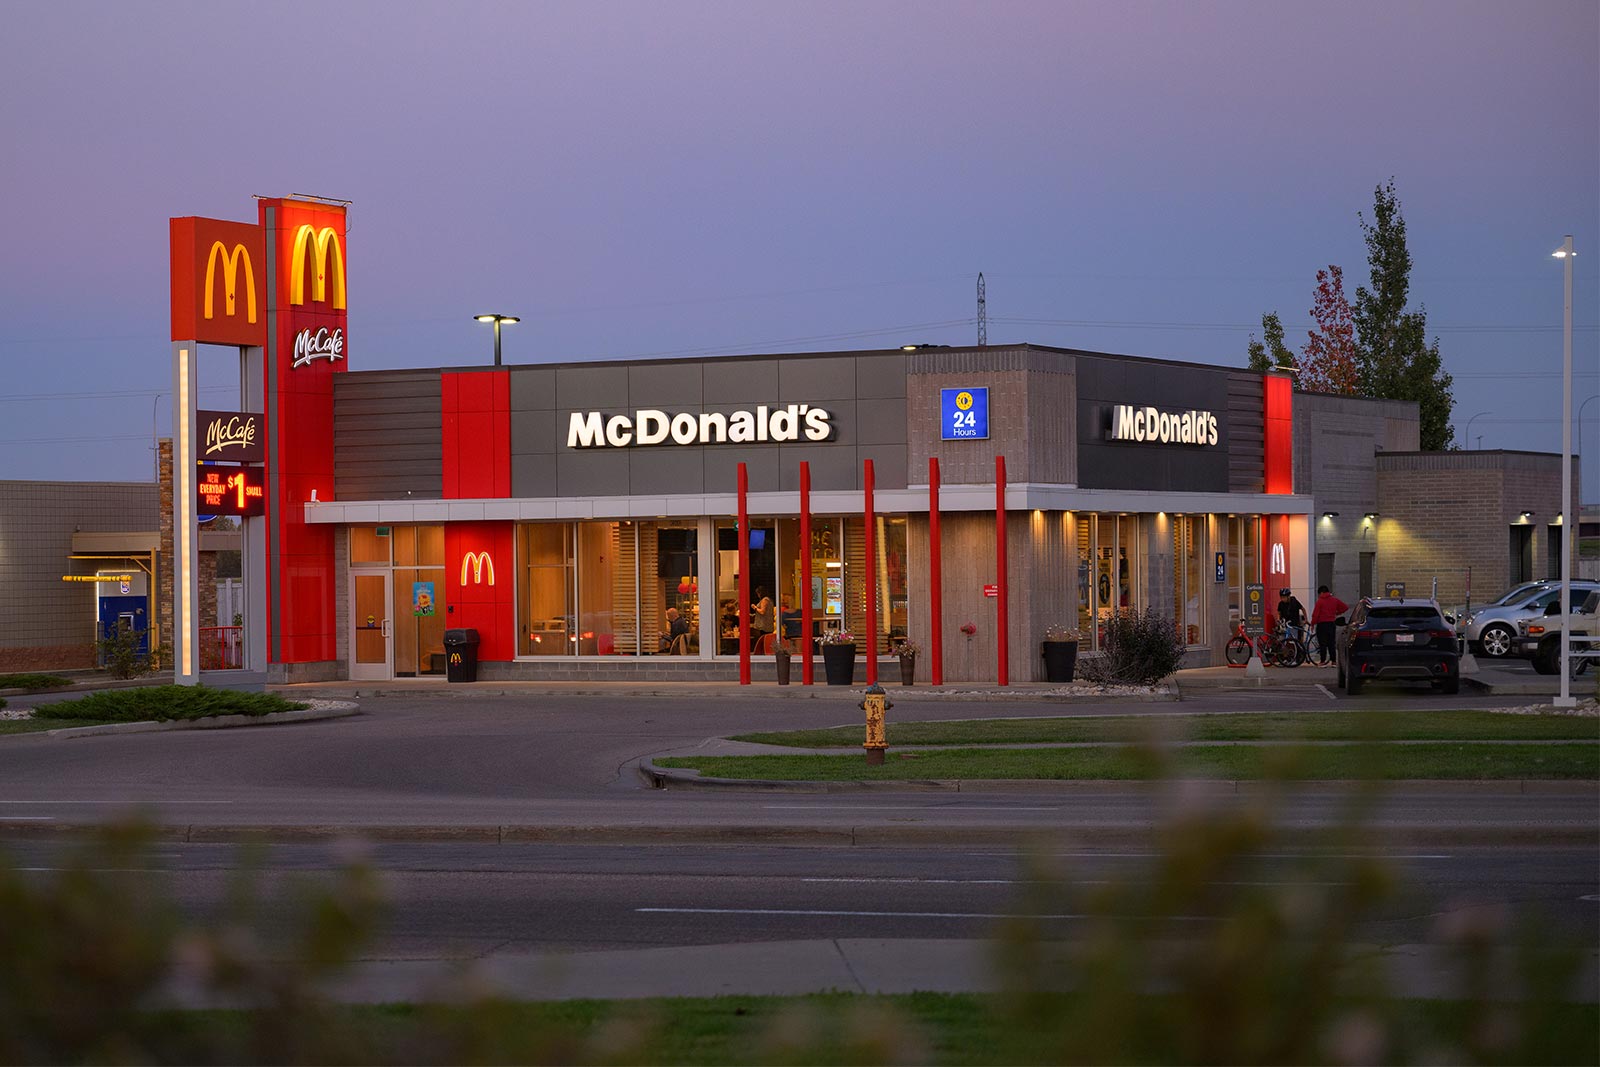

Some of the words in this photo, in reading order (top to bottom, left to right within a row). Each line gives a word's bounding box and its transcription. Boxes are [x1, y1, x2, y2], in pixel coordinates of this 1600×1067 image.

[293, 327, 344, 368] McCafé
[567, 404, 831, 447] McDonald's
[953, 411, 976, 428] 24
[1112, 405, 1218, 445] McDonald's
[206, 416, 256, 455] McCafé
[953, 428, 977, 436] Hours
[200, 483, 226, 495] EVERYDAY
[246, 486, 263, 497] SMALL
[206, 494, 221, 506] PRICE
